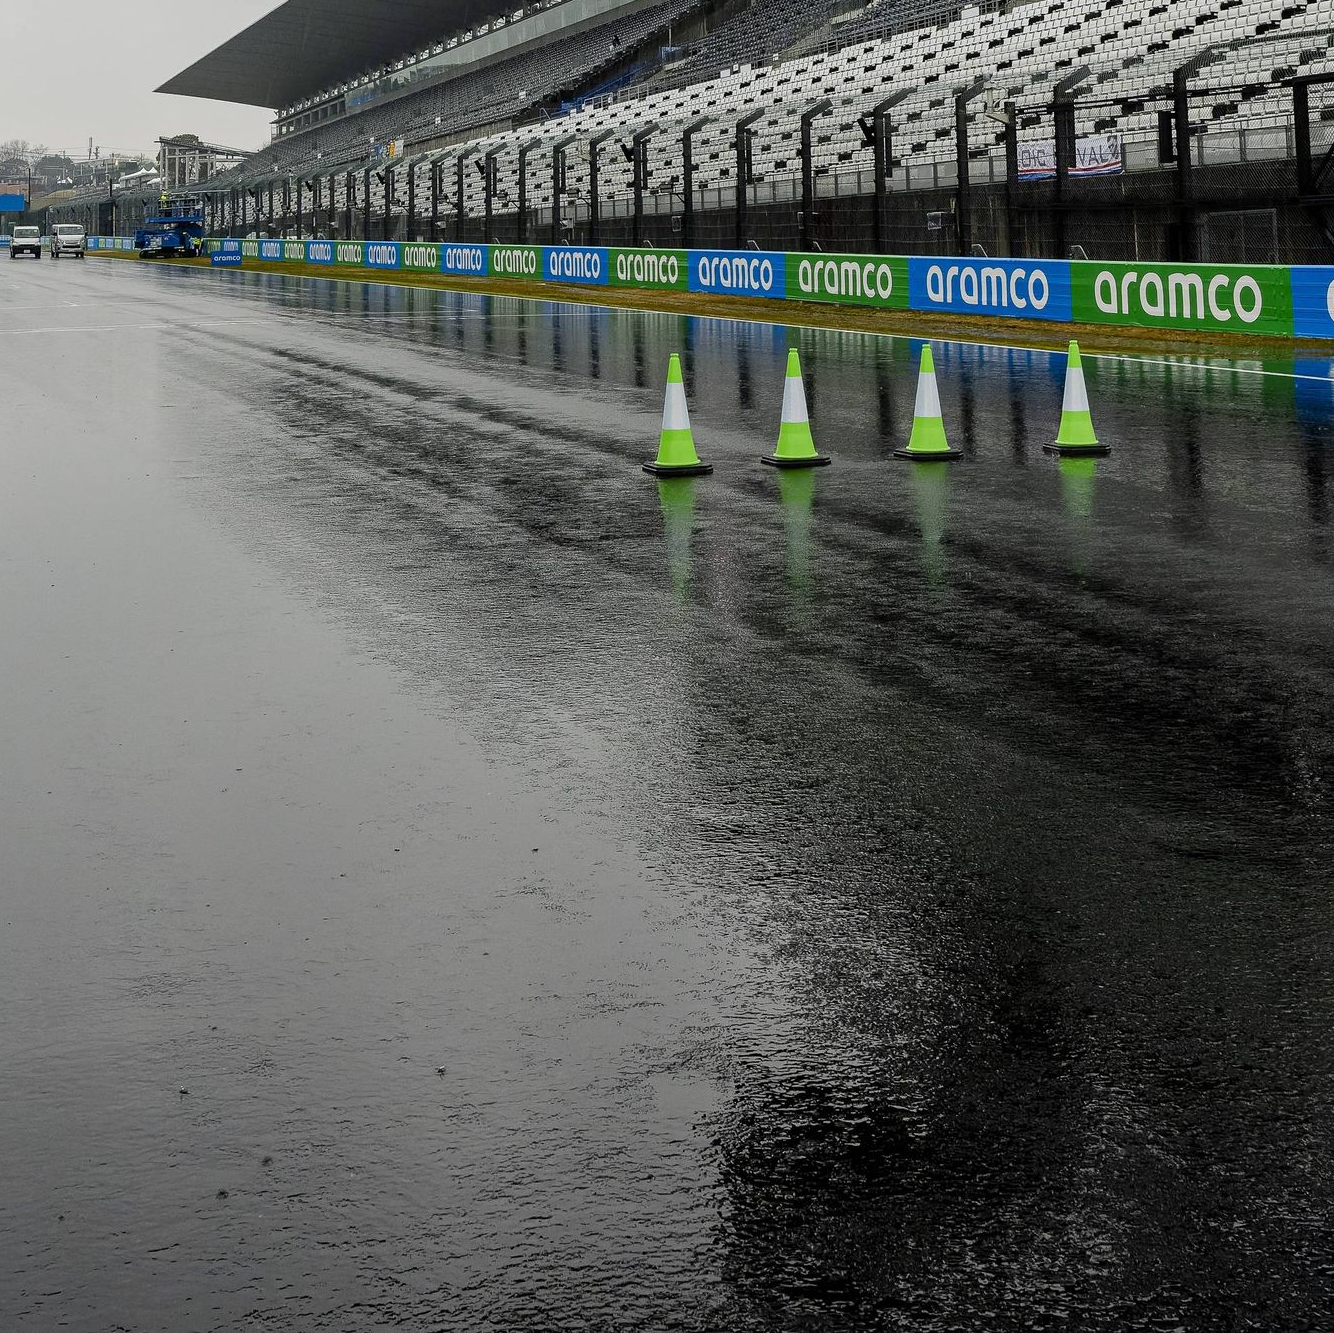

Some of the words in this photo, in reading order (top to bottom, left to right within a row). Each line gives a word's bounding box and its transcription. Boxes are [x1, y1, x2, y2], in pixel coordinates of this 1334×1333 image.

[284, 243, 305, 260] aramco
[309, 244, 332, 261] aramco
[337, 244, 362, 263] aramco
[368, 245, 396, 265] aramco
[404, 246, 437, 268] aramco
[446, 248, 482, 271] aramco
[493, 249, 536, 274] aramco
[550, 251, 601, 279] aramco
[617, 253, 679, 284] aramco
[698, 257, 773, 291] aramco
[798, 259, 893, 299] aramco
[926, 266, 1050, 310] aramco
[1094, 270, 1263, 324] aramco
